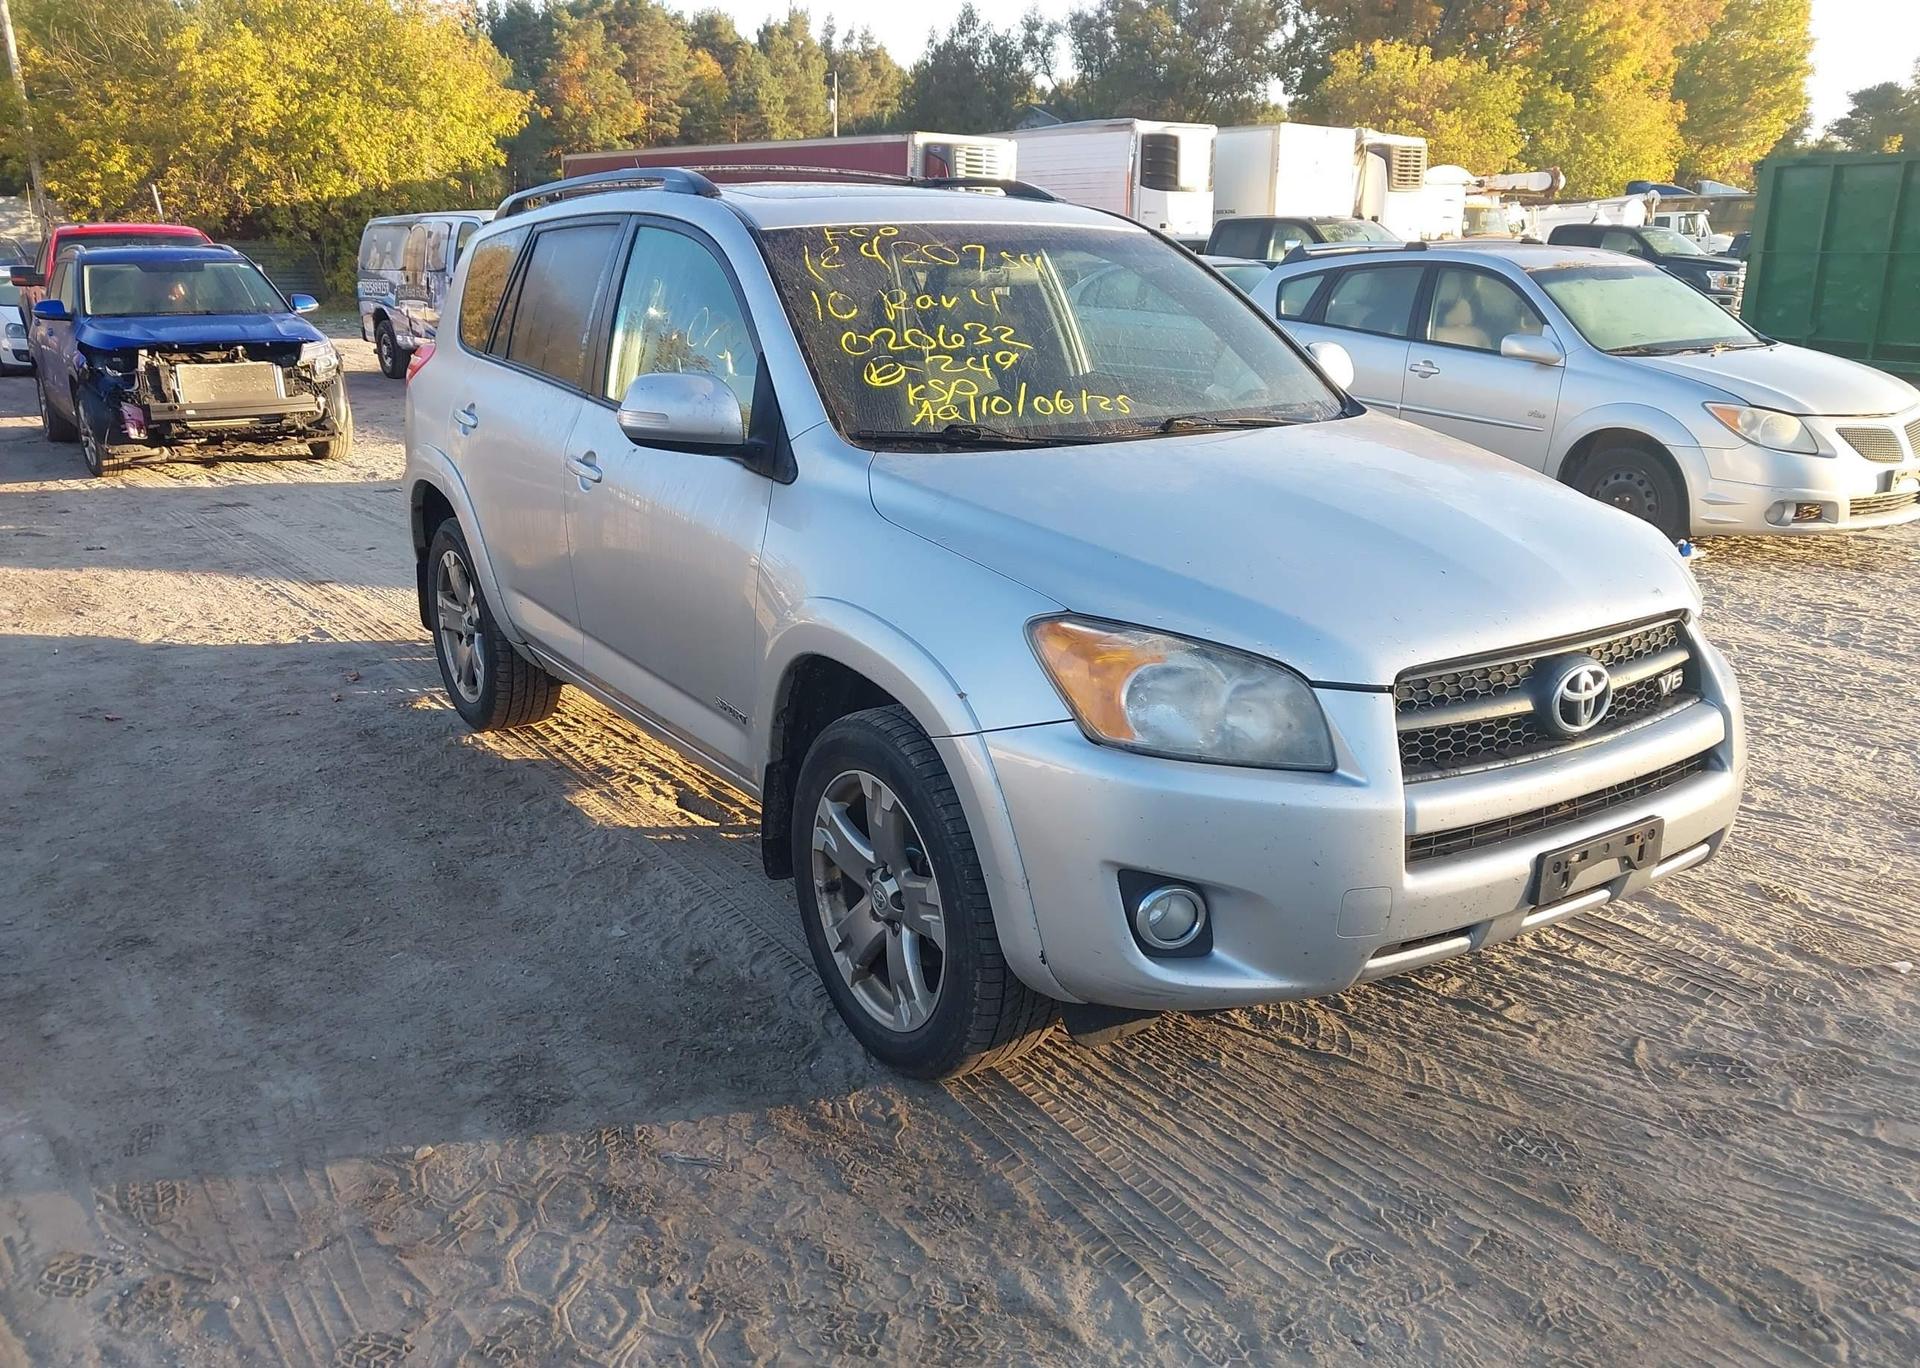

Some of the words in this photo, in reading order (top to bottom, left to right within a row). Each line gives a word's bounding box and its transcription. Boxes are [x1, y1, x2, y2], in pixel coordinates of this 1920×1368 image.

[811, 289, 858, 320] 10
[841, 321, 1034, 356] 020632
[925, 350, 1020, 380] 249
[1658, 668, 1684, 694] V6
